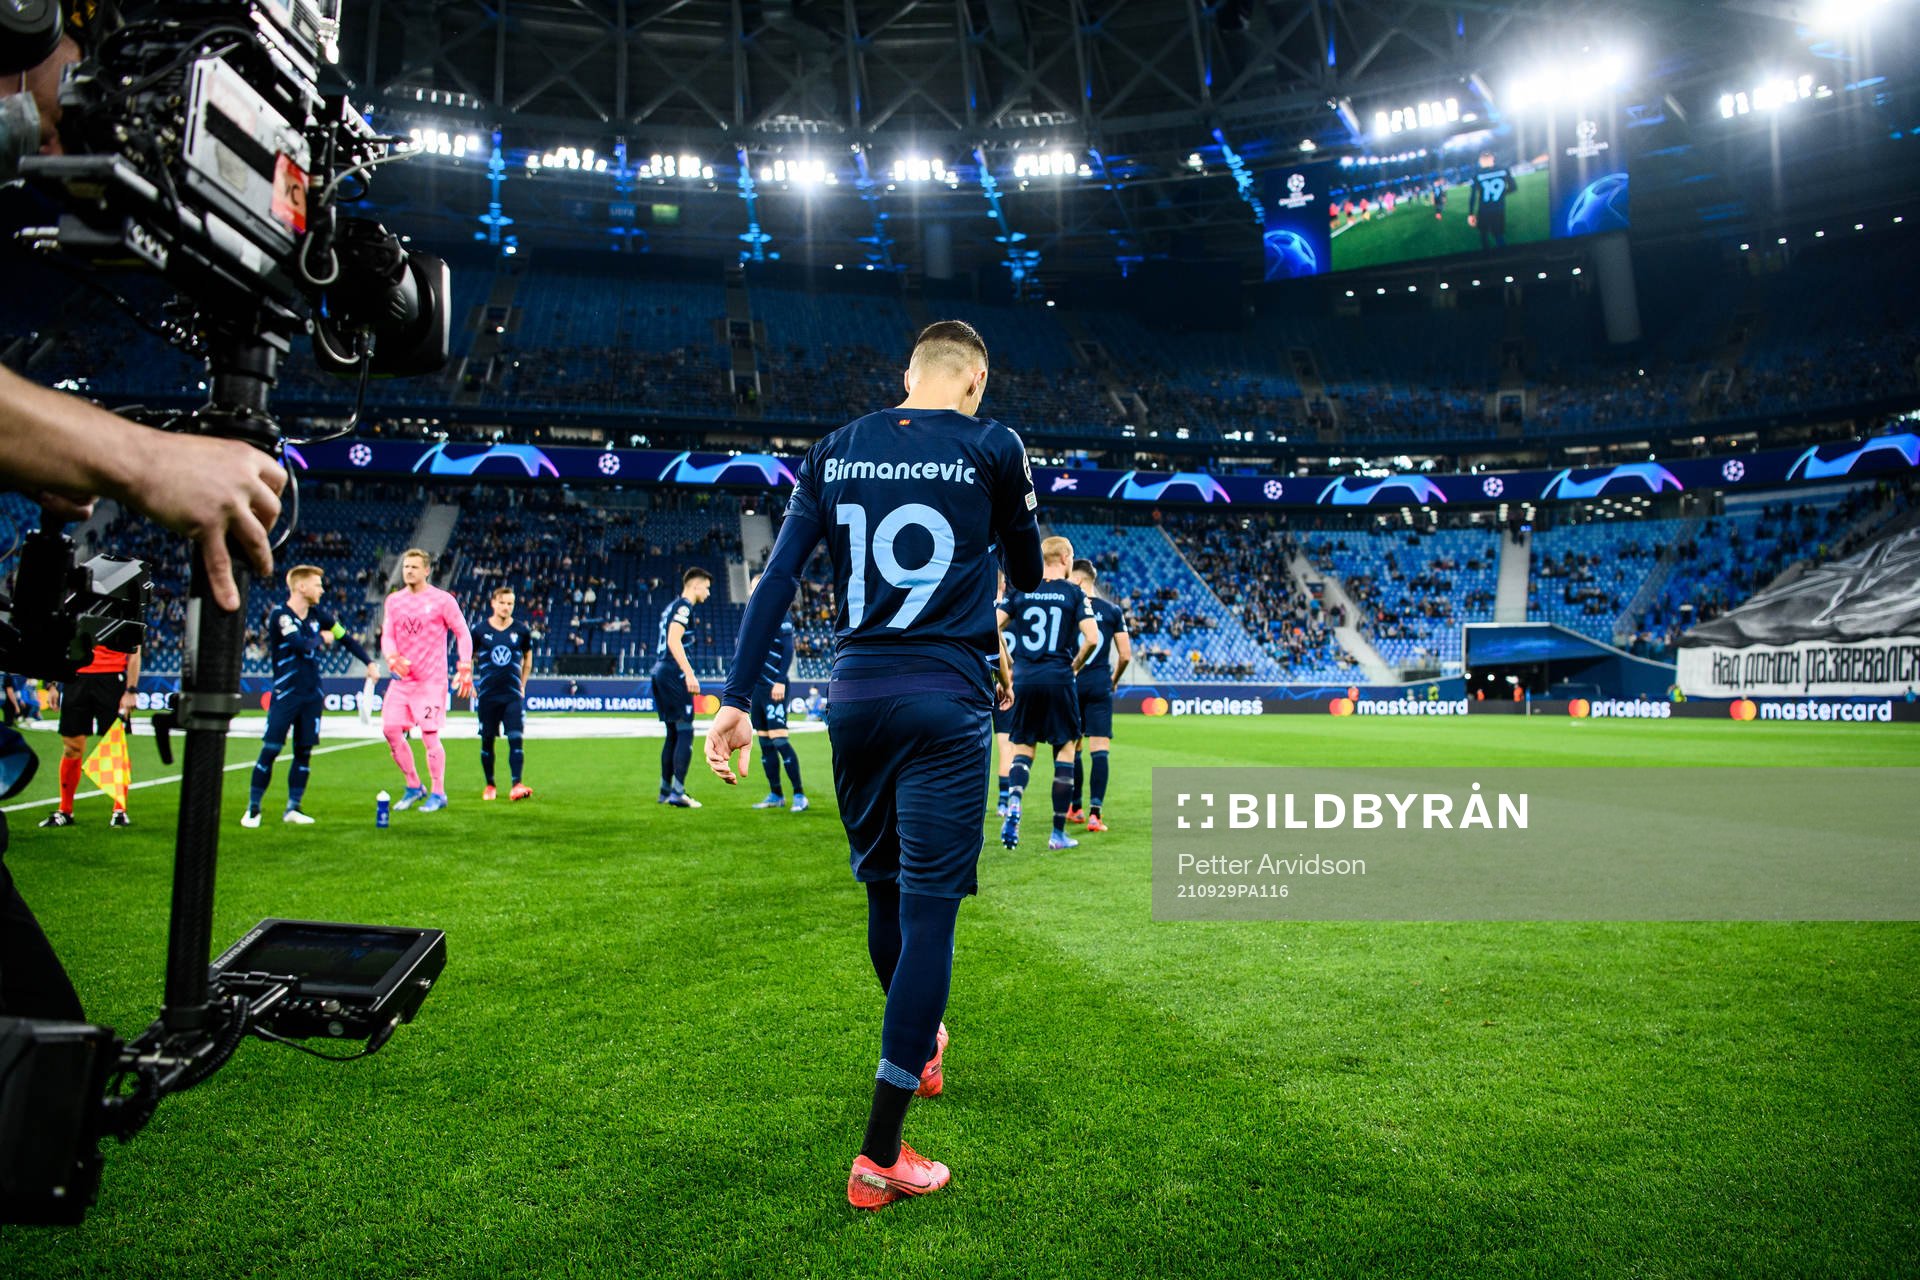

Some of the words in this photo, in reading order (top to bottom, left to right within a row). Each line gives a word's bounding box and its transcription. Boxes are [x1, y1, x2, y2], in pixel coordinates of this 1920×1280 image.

[1481, 178, 1505, 202] 19
[824, 458, 976, 484] Birmancevic
[836, 503, 956, 630] 19
[1022, 606, 1062, 652] 31
[424, 706, 441, 719] 27
[526, 696, 603, 711] CHAMPIONS
[604, 697, 654, 711] LEAGUE
[766, 703, 785, 720] 24
[1171, 696, 1264, 716] priceless
[1357, 698, 1469, 715] mastercard
[1591, 699, 1671, 718] priceless
[1760, 699, 1892, 722] mastercard
